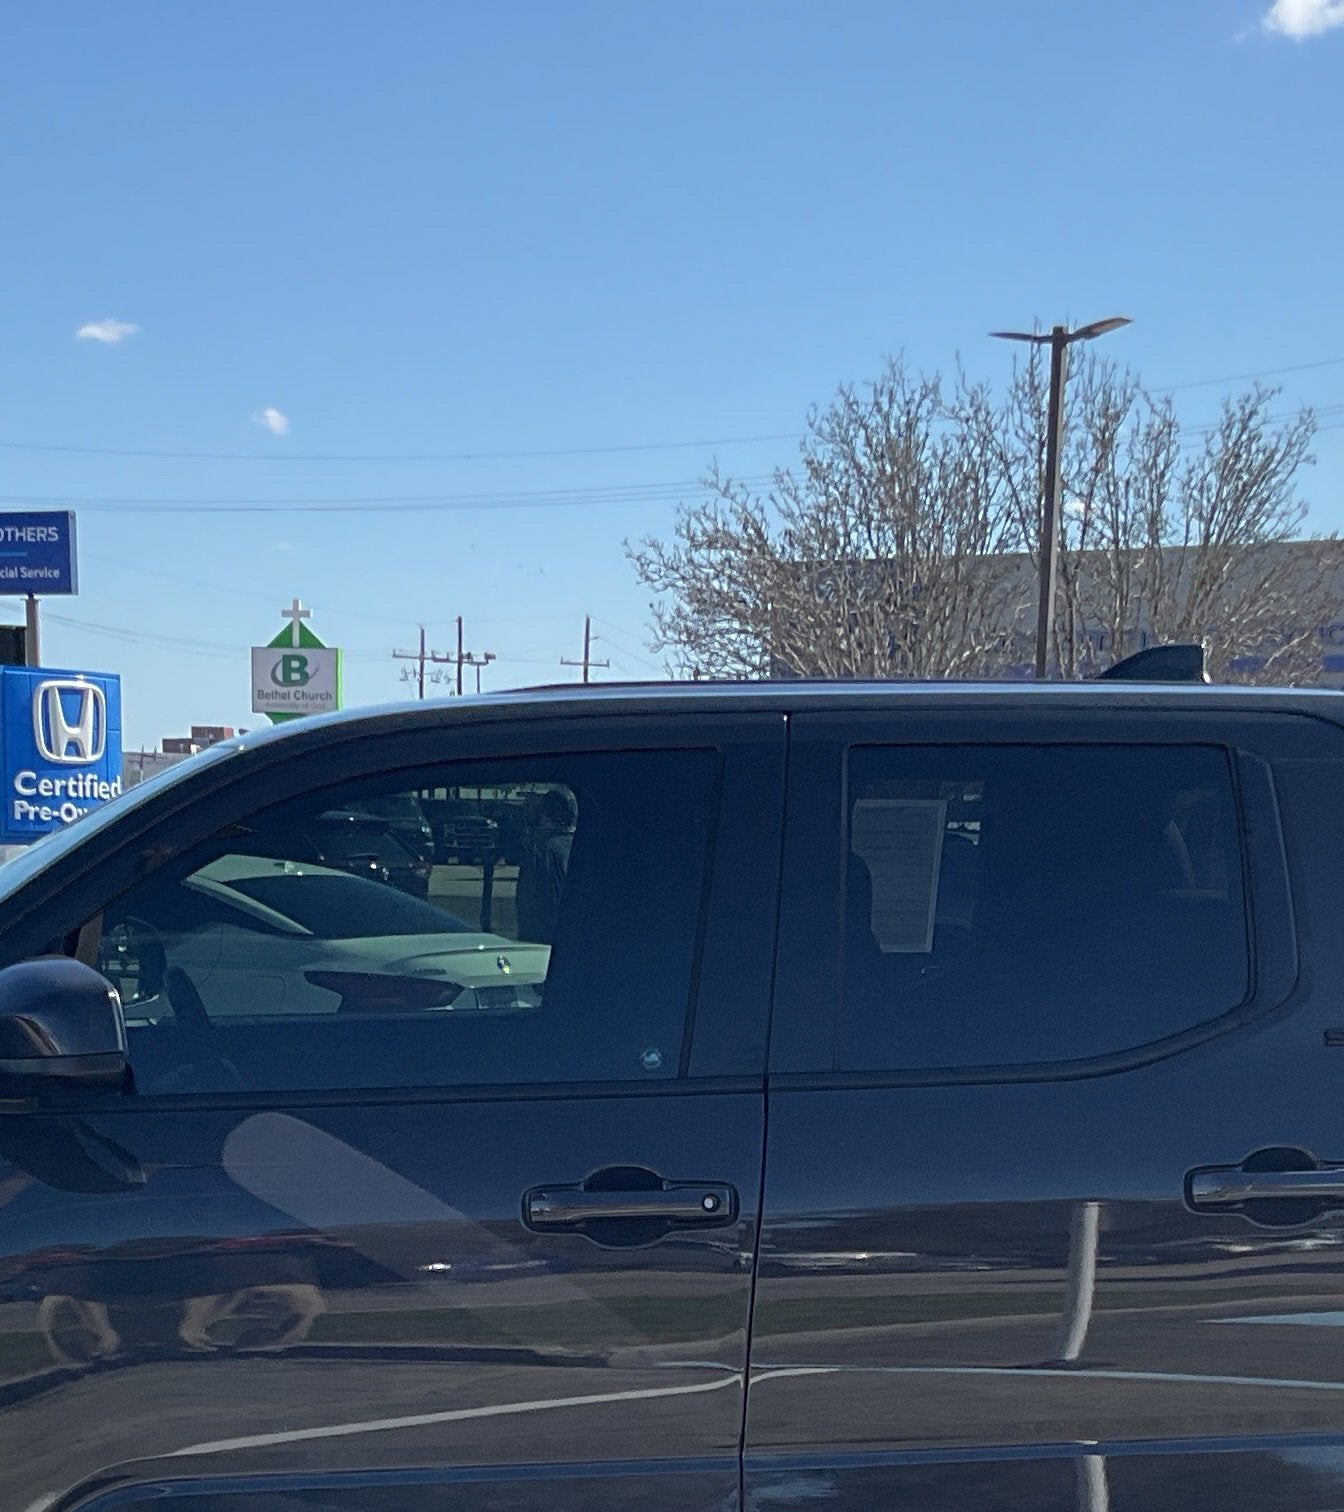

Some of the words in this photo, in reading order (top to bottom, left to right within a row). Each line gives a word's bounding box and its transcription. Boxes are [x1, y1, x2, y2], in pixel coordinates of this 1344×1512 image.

[20, 566, 60, 579] Service
[282, 654, 310, 687] B
[257, 689, 291, 701] Bethel
[293, 690, 333, 701] Church
[13, 771, 123, 800] Certified
[13, 800, 89, 823] Pre-O
